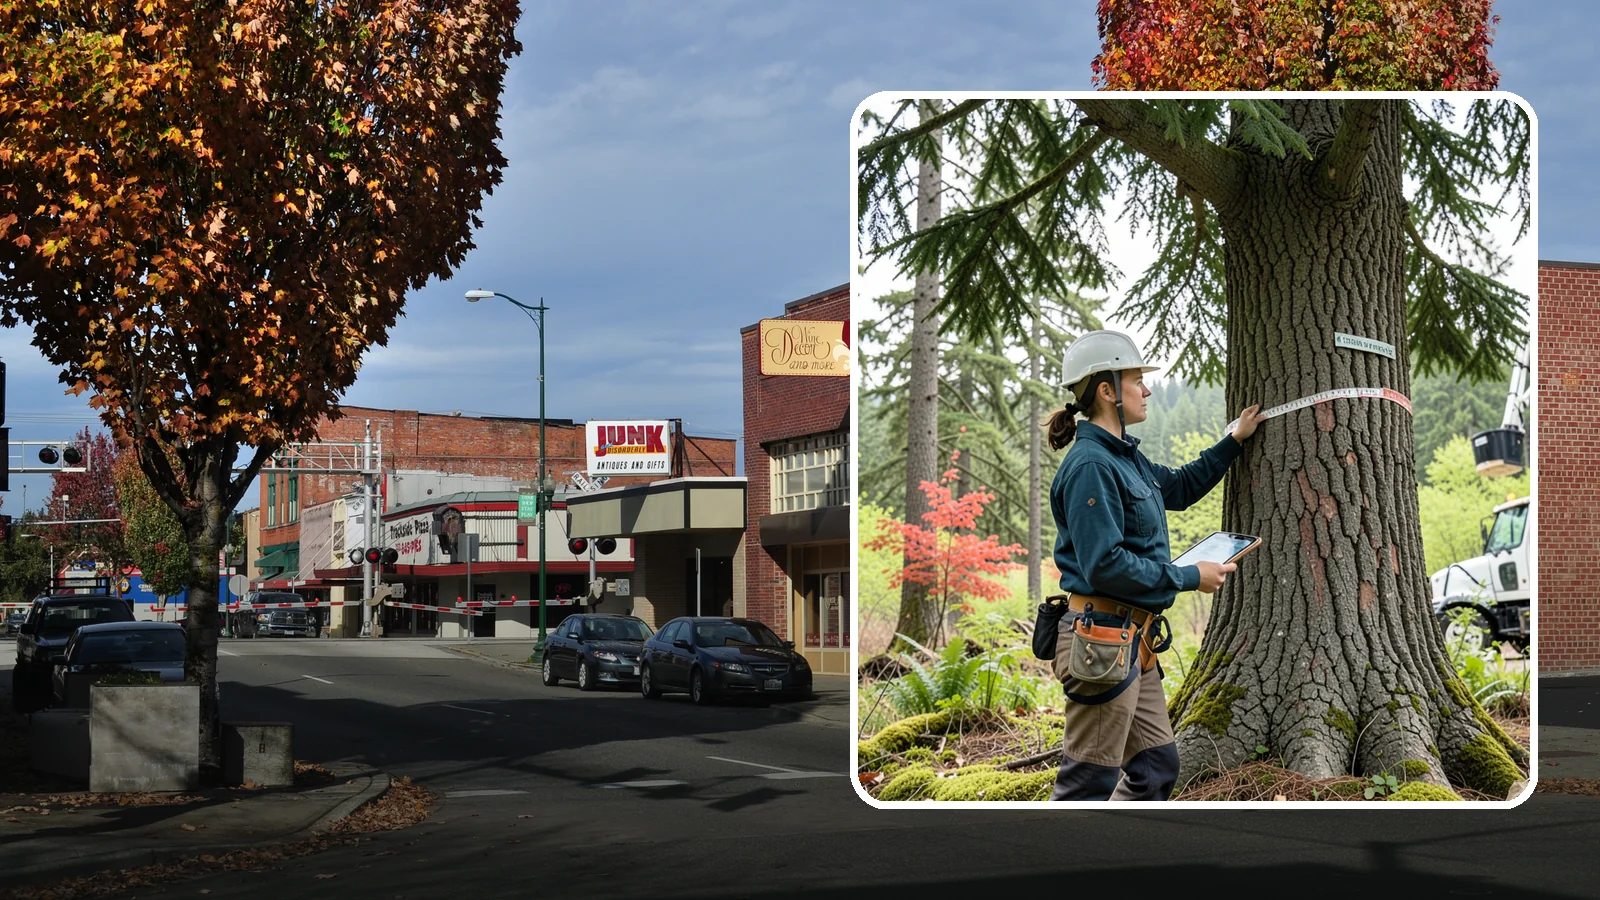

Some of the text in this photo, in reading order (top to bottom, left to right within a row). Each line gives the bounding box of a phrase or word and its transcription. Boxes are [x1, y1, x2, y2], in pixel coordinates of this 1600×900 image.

[595, 425, 665, 457] JUNK
[607, 446, 646, 454] DISORDERLY
[596, 460, 665, 470] ANTIQUES AND GIFTS
[352, 498, 365, 511] CRO
[414, 519, 429, 535] Pizza
